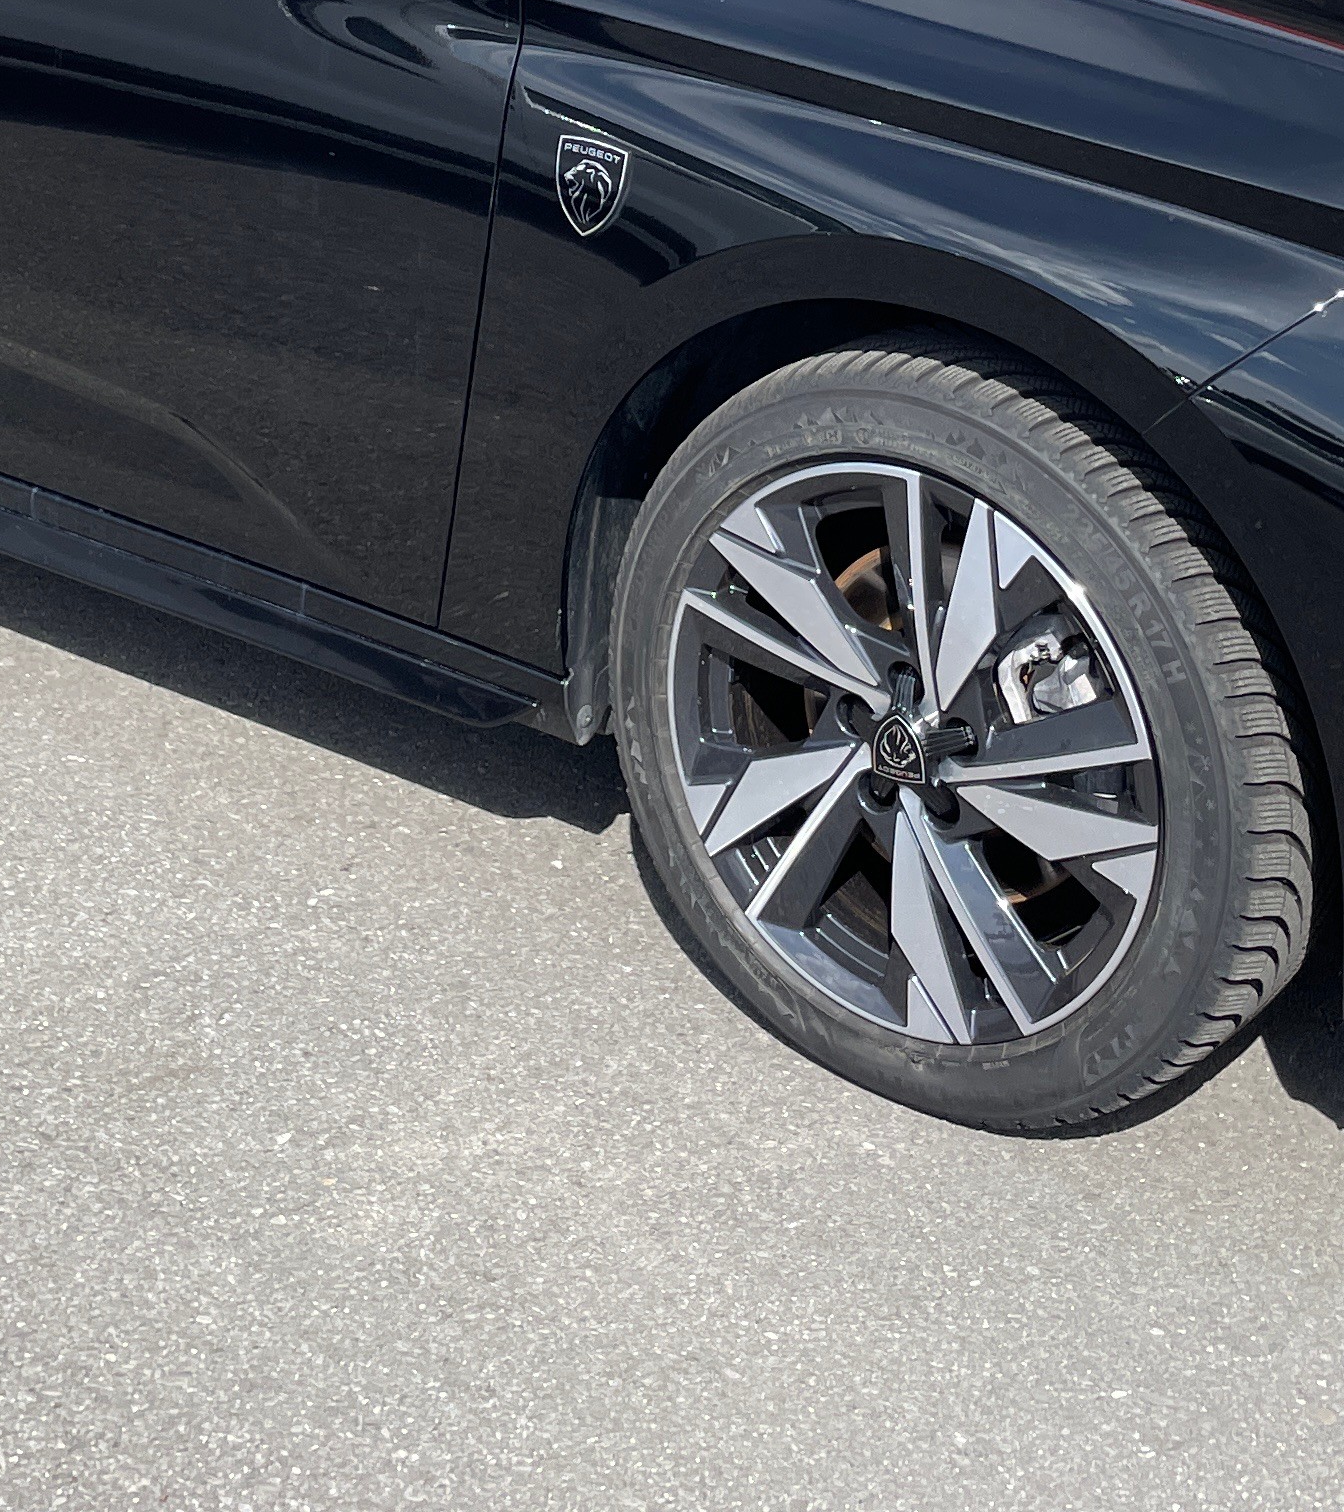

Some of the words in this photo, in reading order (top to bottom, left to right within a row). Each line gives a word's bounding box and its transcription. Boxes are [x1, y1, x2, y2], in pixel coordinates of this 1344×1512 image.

[564, 142, 621, 164] PEUGEOT
[1144, 618, 1173, 650] 17
[1160, 658, 1187, 685] H
